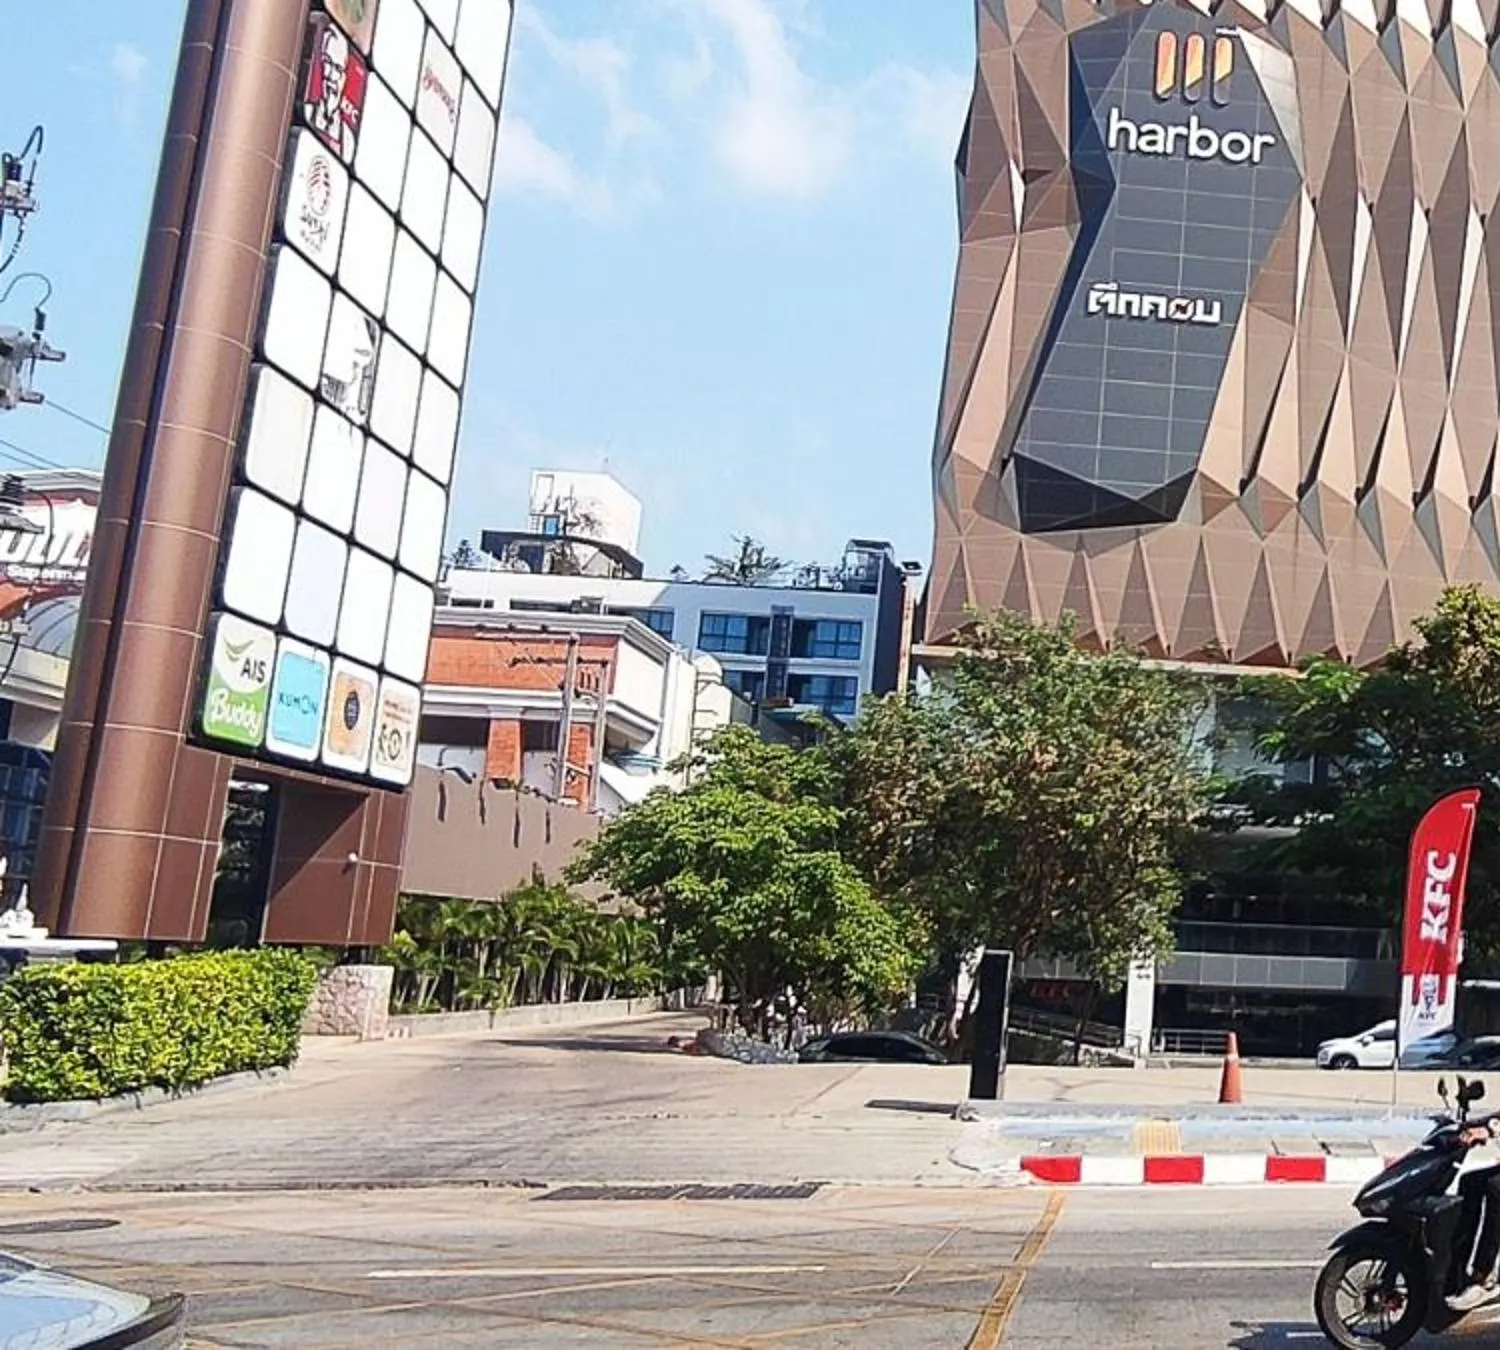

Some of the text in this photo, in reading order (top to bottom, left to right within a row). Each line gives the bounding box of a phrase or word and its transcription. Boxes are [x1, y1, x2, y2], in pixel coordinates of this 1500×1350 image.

[1107, 107, 1275, 163] harbor
[1087, 282, 1221, 323] ตึกคอม
[240, 657, 267, 684] AIS
[210, 687, 260, 738] Buddy
[278, 692, 318, 716] KUMON
[1420, 850, 1457, 944] KFC
